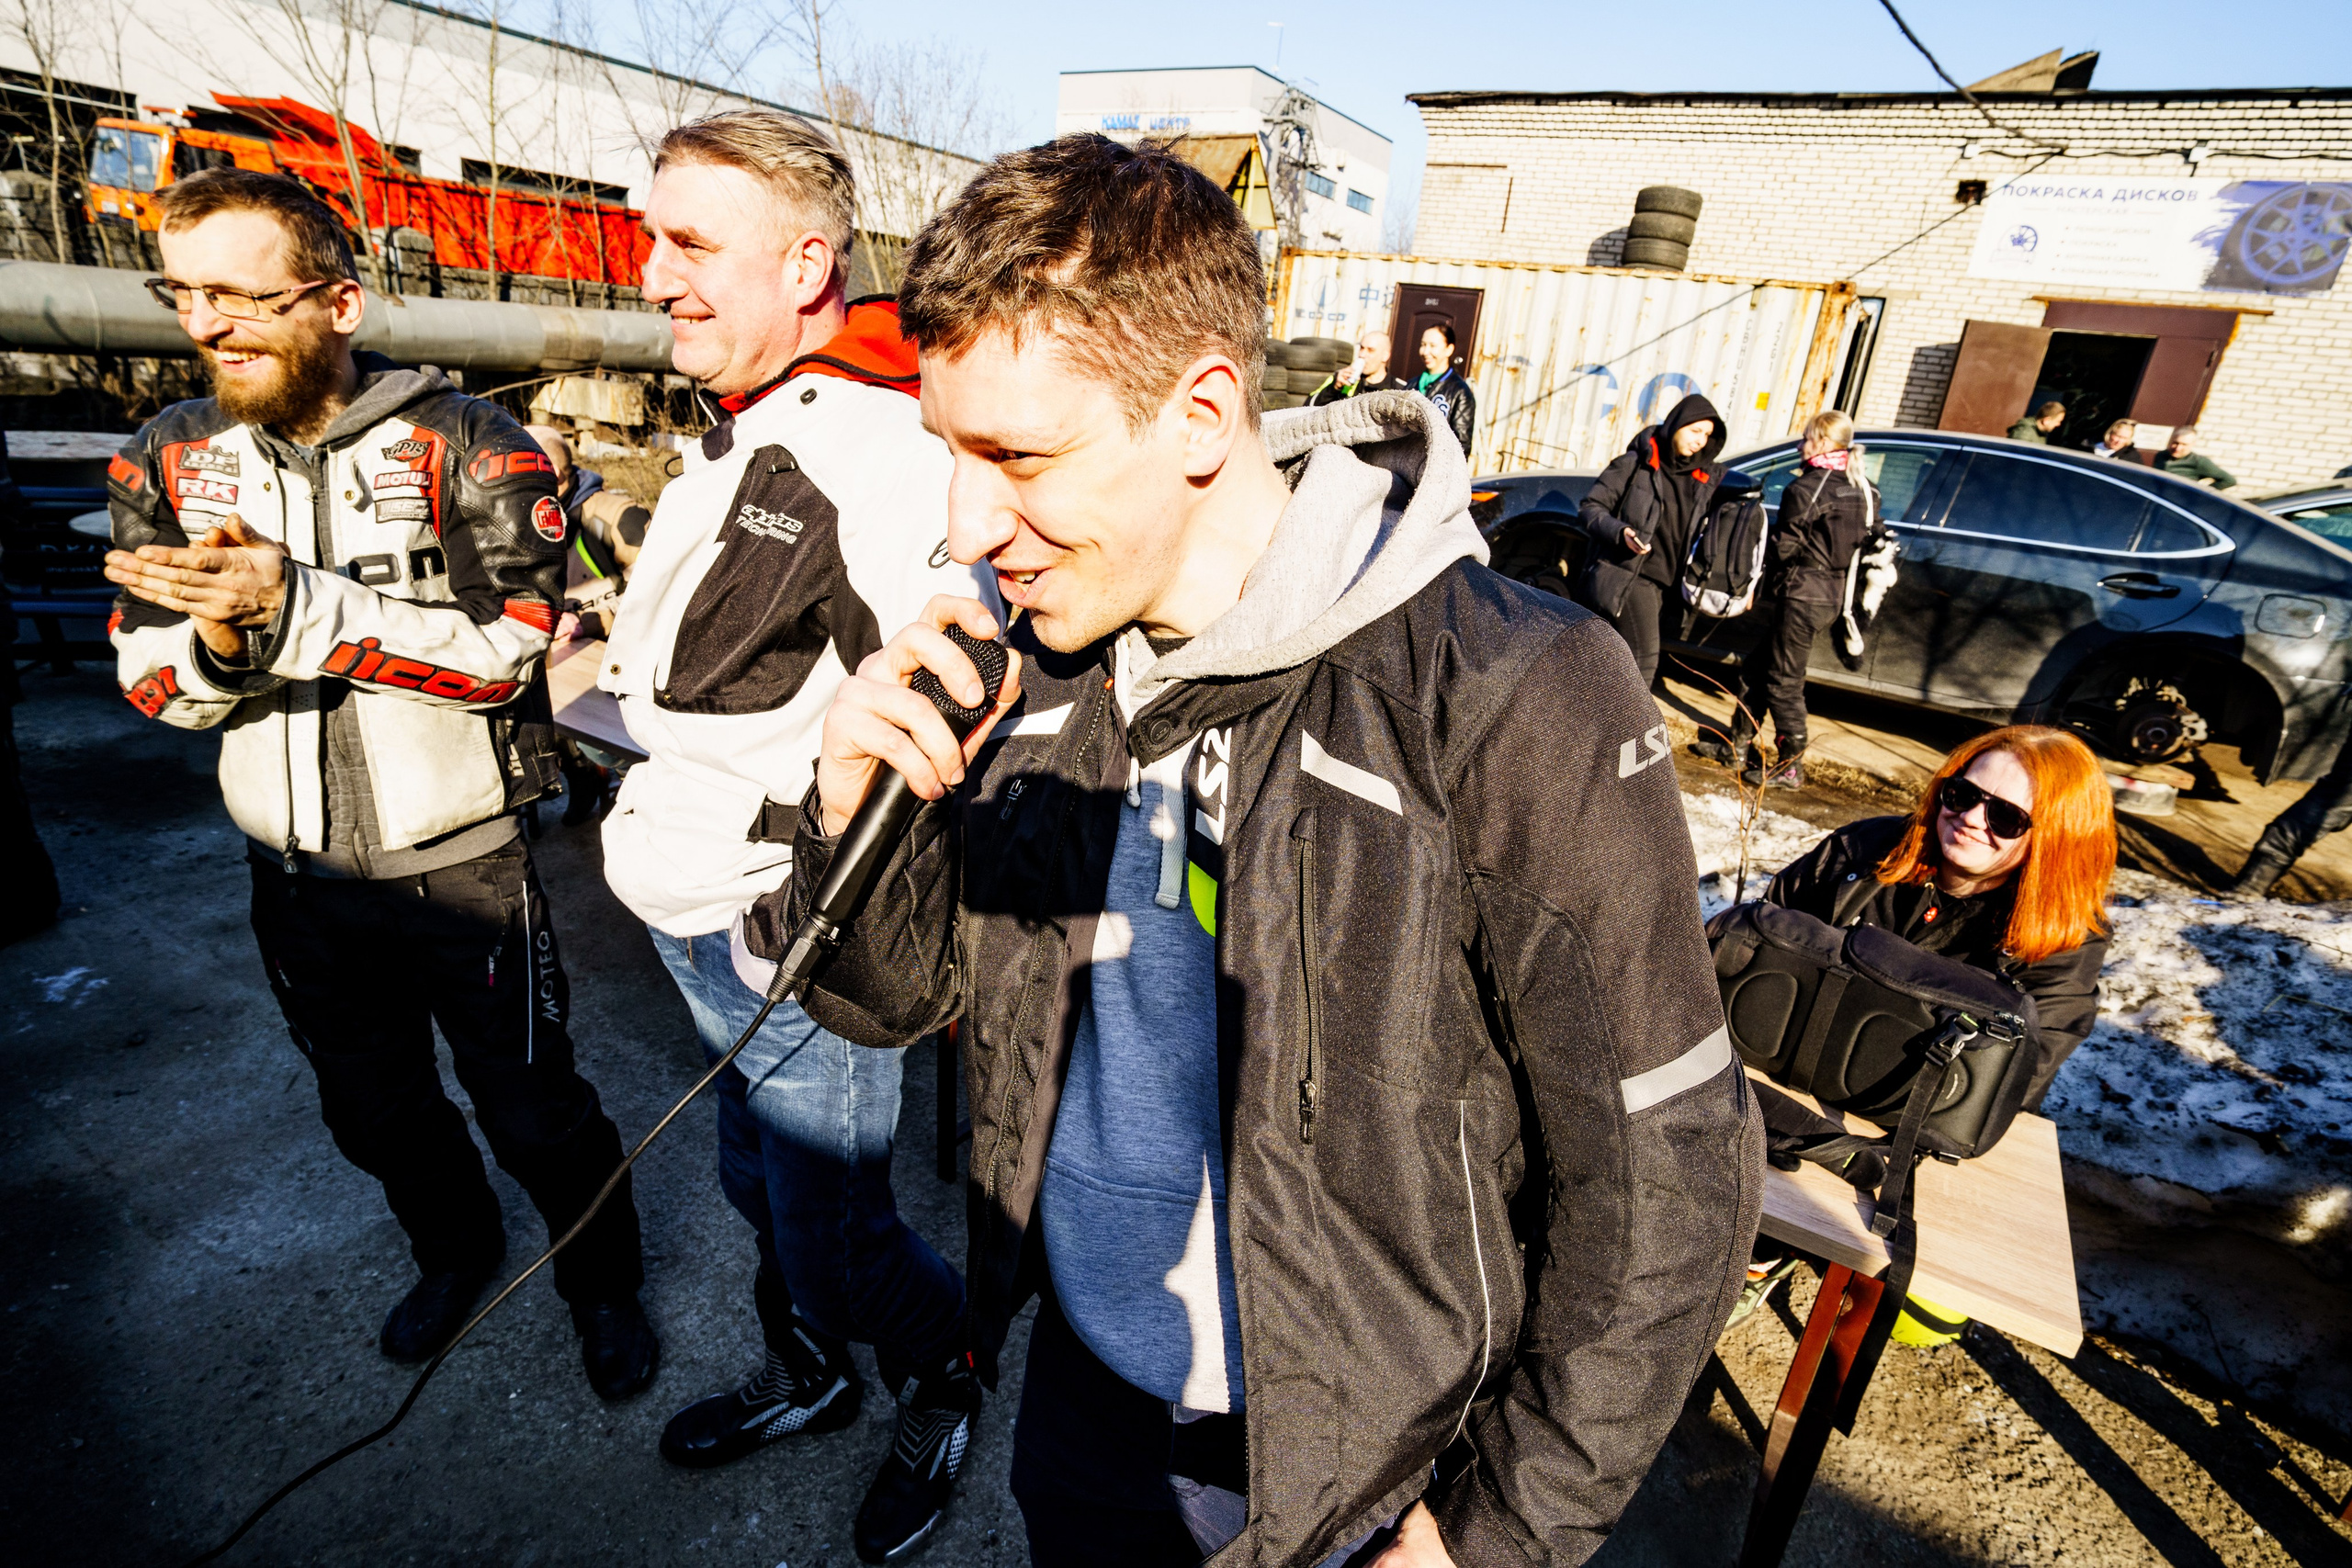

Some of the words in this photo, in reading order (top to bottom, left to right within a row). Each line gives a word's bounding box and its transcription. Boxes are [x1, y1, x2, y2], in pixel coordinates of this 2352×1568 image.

[2002, 185, 2104, 199] ПОКРАСКА
[2111, 188, 2199, 203] ДИСКОВ
[177, 478, 238, 502] RK
[375, 470, 430, 489] MOTUL
[1618, 722, 1672, 779] LS2
[1194, 727, 1232, 846] LS2
[537, 931, 560, 1023] MOTEQ
